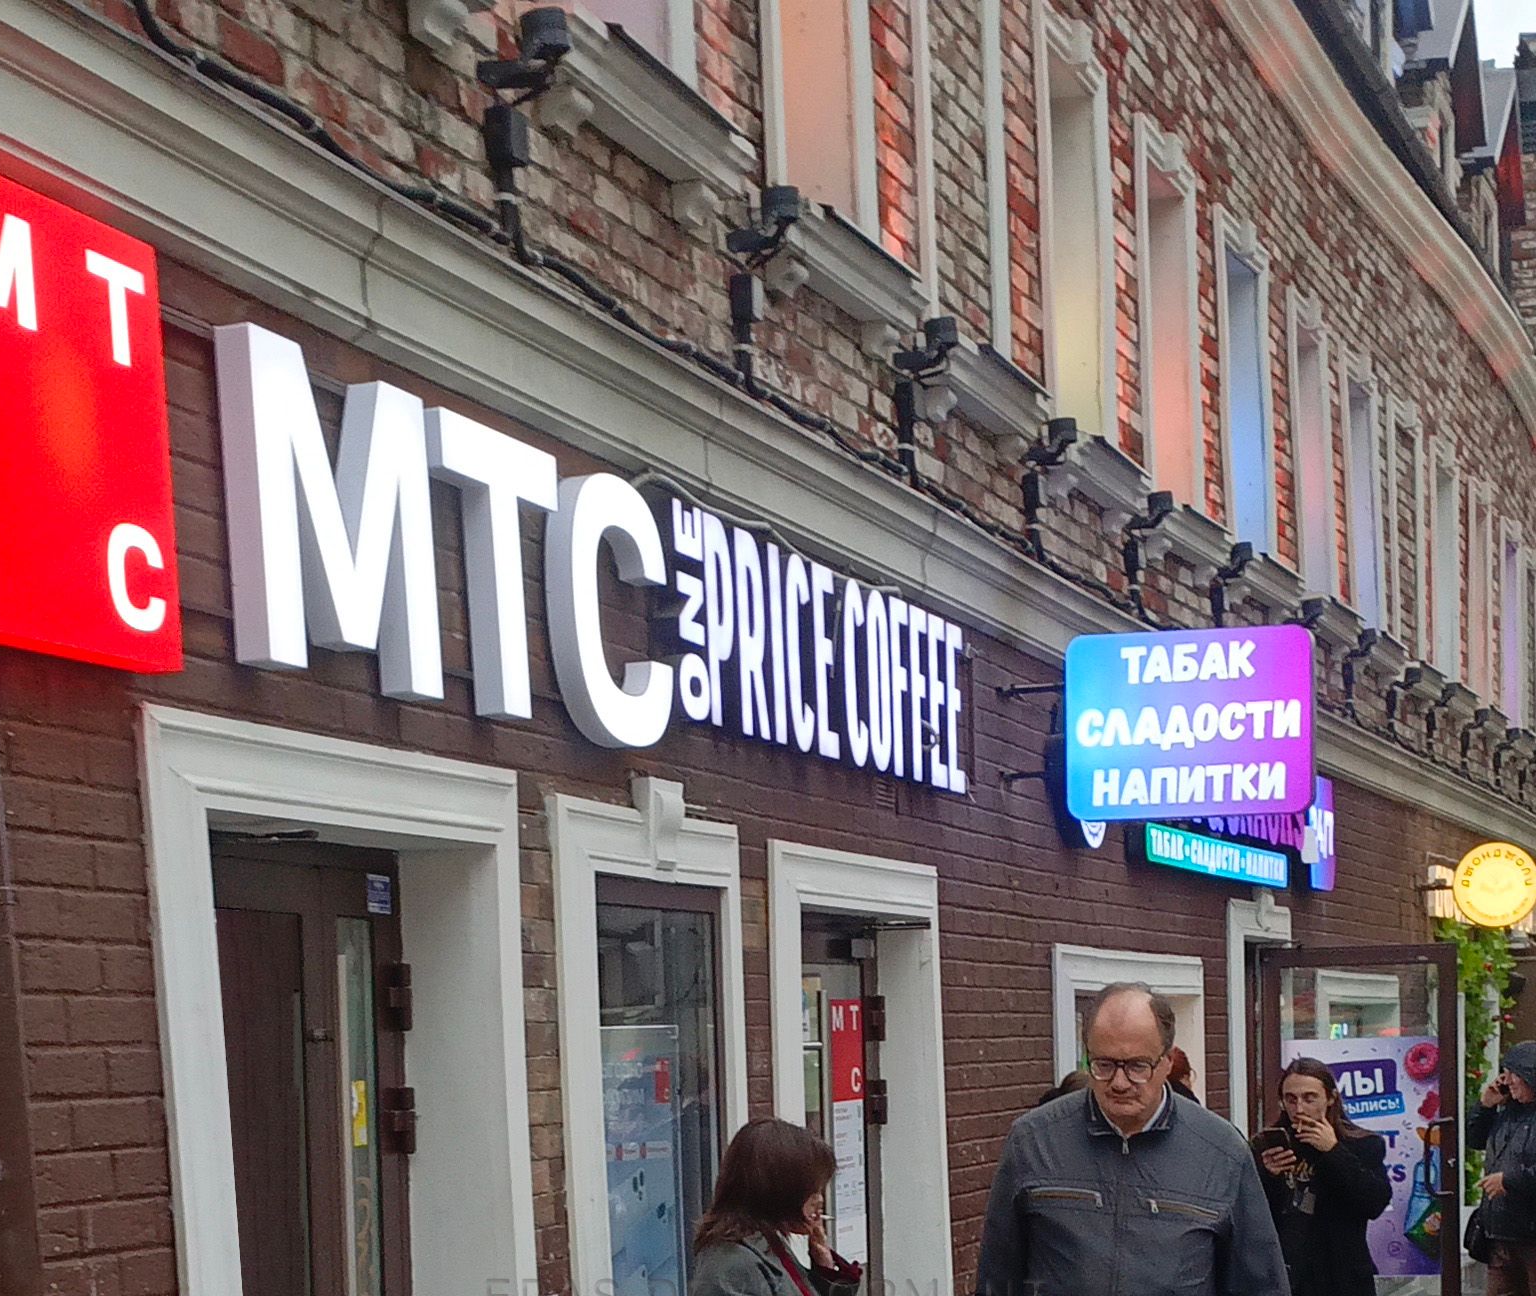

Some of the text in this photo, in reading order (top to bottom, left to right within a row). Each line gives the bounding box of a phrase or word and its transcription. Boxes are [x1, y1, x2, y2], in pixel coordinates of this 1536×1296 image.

[214, 321, 675, 749] МТС
[671, 499, 967, 795] ONE PRICE COFFEE
[1119, 639, 1257, 685] ТАБАК
[1075, 699, 1303, 750] СЛАДОСТИ
[1090, 760, 1288, 806] НАПИТКИ
